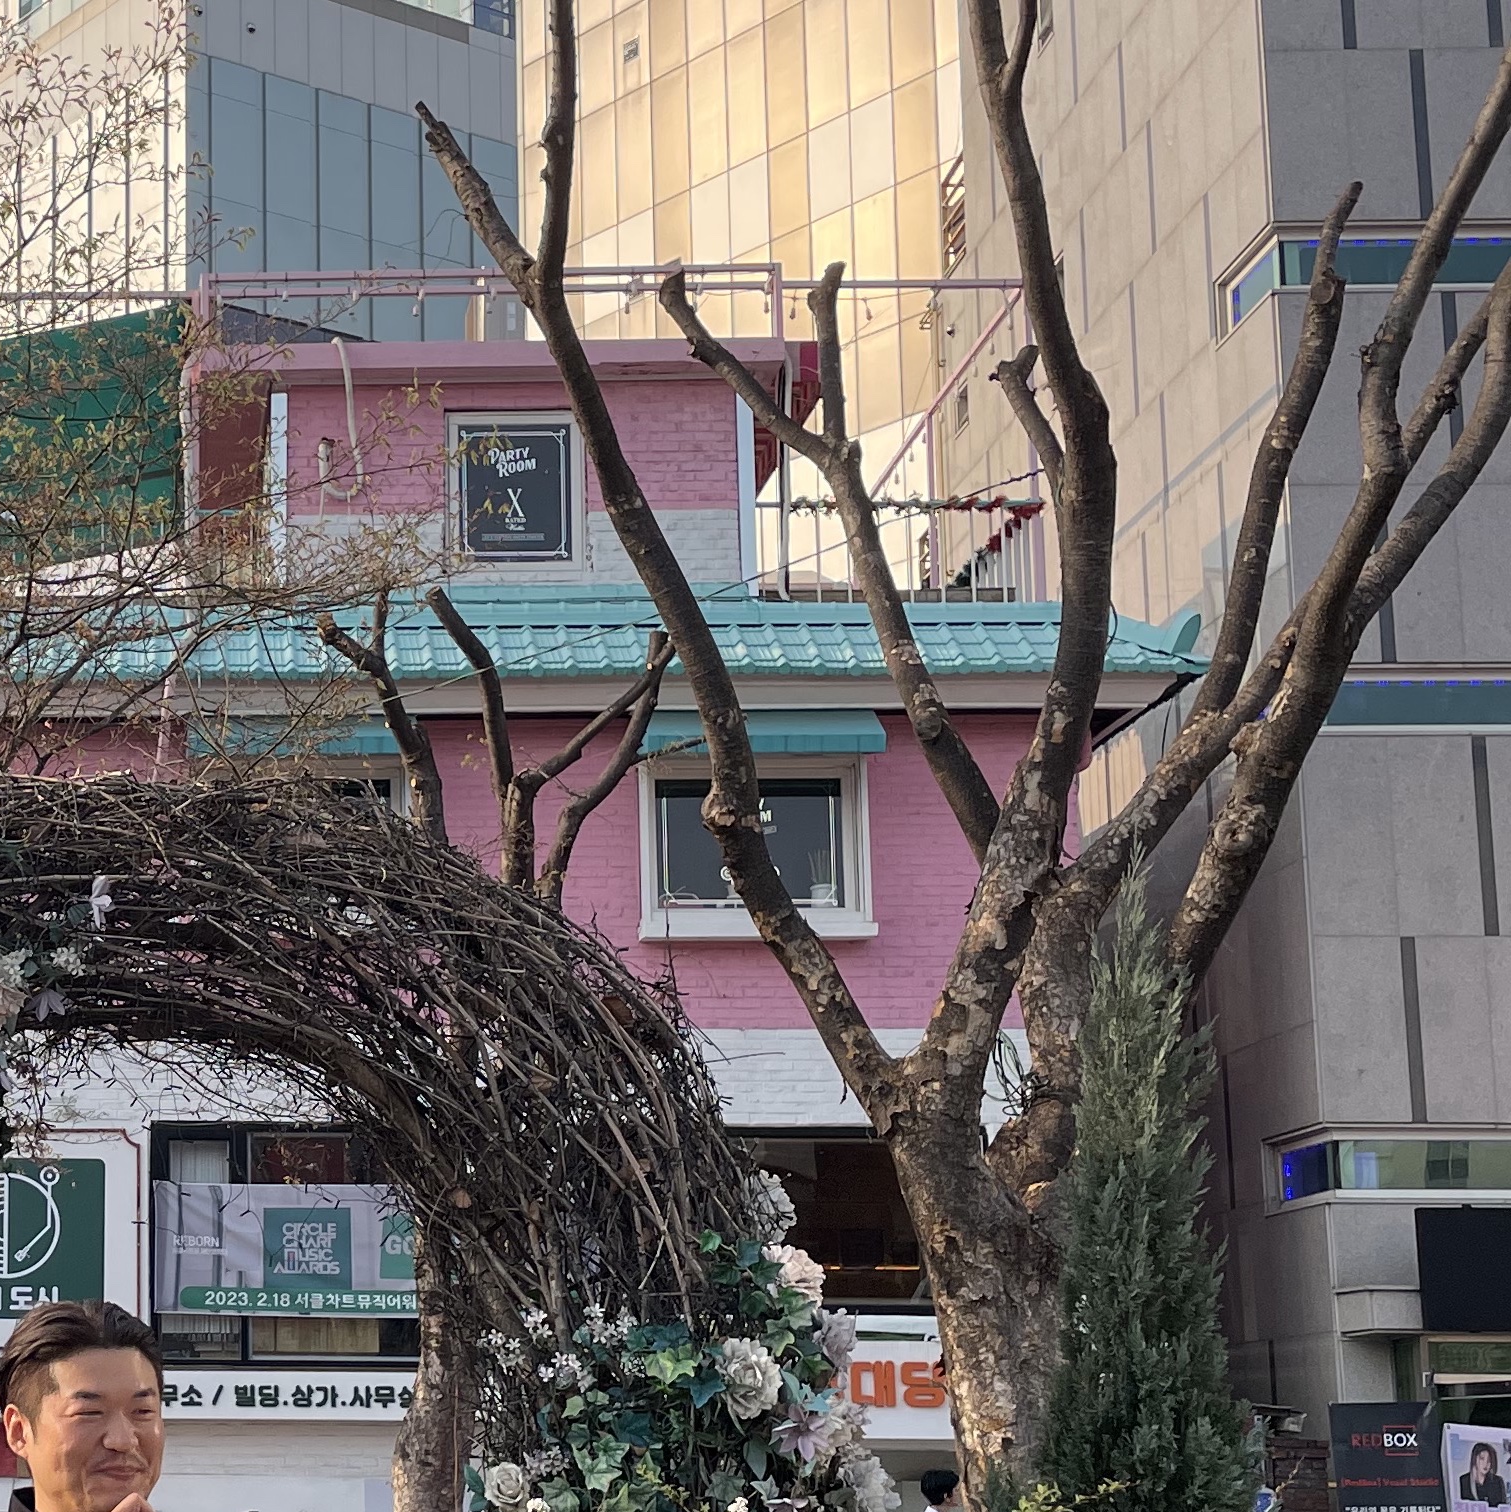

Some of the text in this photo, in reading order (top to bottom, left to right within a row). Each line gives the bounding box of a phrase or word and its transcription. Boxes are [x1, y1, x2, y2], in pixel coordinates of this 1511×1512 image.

[488, 447, 530, 465] PARTY
[496, 458, 537, 478] ROOM
[282, 1222, 337, 1236] CIRCLE
[9, 1285, 59, 1311] 도시
[205, 1290, 253, 1307] 2023.
[256, 1292, 291, 1308] 2.18
[211, 1384, 224, 1406] /
